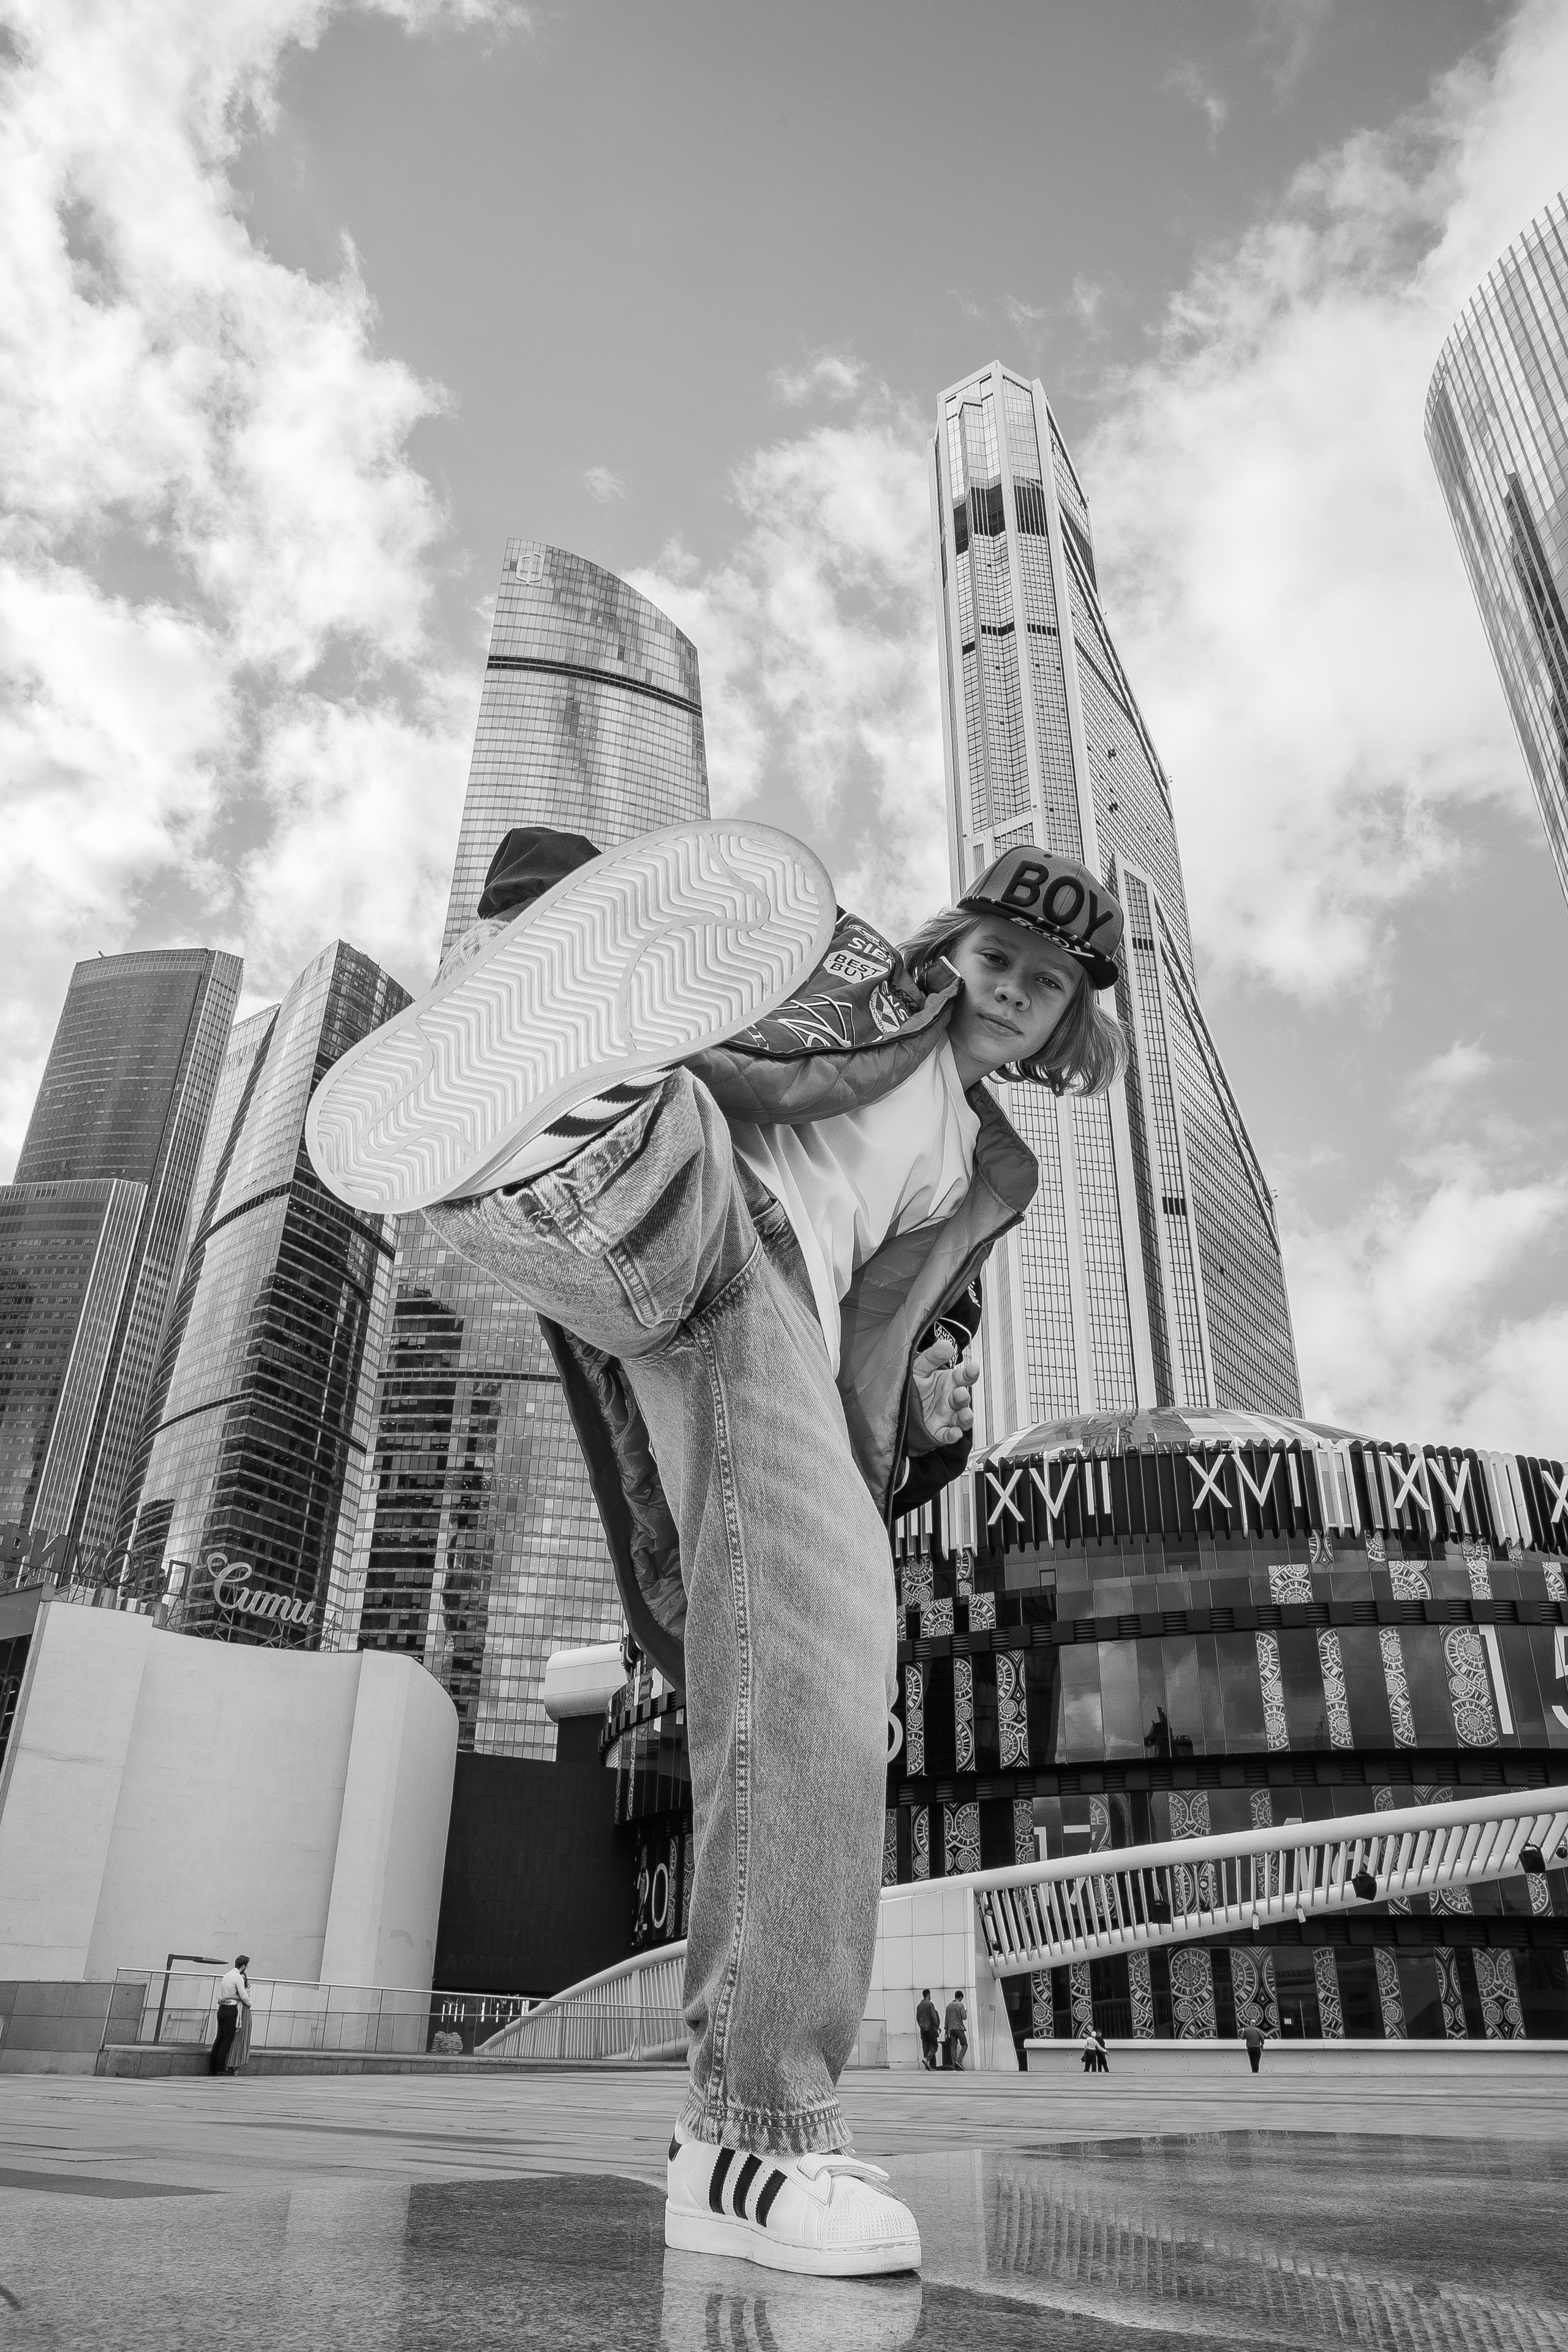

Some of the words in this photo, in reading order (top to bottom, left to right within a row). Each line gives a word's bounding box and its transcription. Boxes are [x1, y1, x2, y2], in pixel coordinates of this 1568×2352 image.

[1001, 860, 1115, 943] BOY
[829, 962, 871, 981] BUY
[833, 953, 883, 975] BEST
[937, 1325, 954, 1344] Auto
[986, 1461, 1111, 1526] XVII
[1186, 1453, 1302, 1510] XVI
[1385, 1455, 1470, 1513] XV
[206, 1552, 316, 1626] Сити
